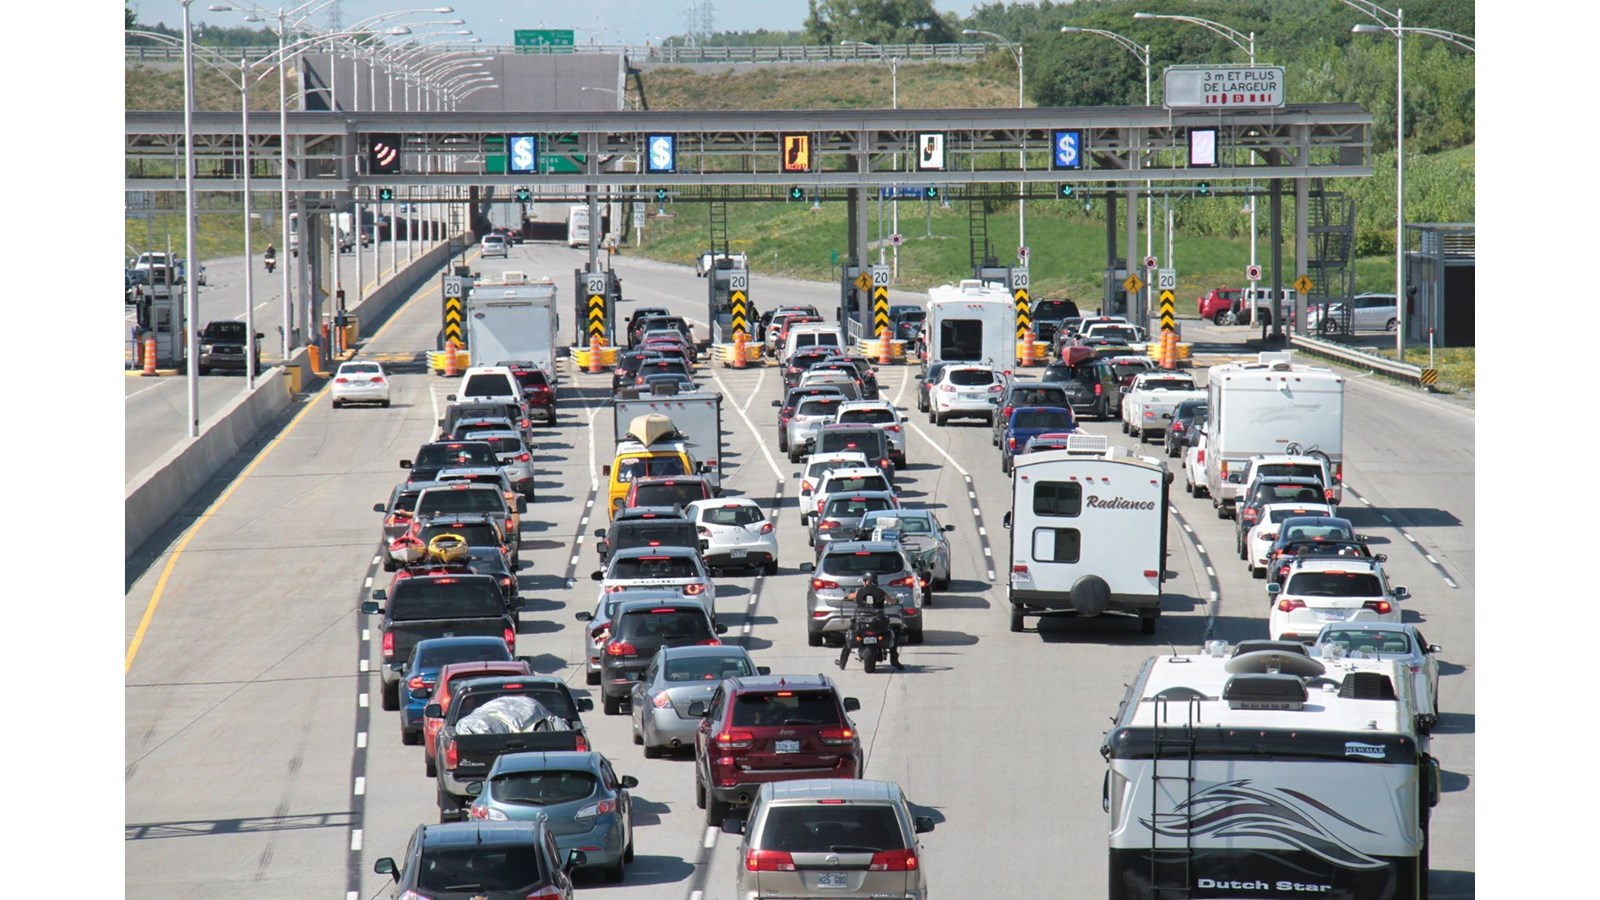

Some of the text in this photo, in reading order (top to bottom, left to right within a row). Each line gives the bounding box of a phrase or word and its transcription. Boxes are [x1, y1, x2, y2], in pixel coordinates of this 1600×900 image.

[1204, 70, 1275, 81] 3 m ET PLUS
[1204, 82, 1277, 92] DE LARGEUR
[514, 137, 532, 170] $
[652, 137, 670, 170] $
[1058, 134, 1076, 165] $
[732, 276, 745, 288] 20
[874, 272, 888, 284] 20
[1014, 274, 1028, 286] 20
[1160, 275, 1174, 287] 20
[446, 283, 460, 294] 20
[589, 280, 603, 292] 20
[1086, 495, 1155, 510] Radiance
[1346, 746, 1384, 754] NEWMAR
[1197, 878, 1332, 892] Dutch Star
